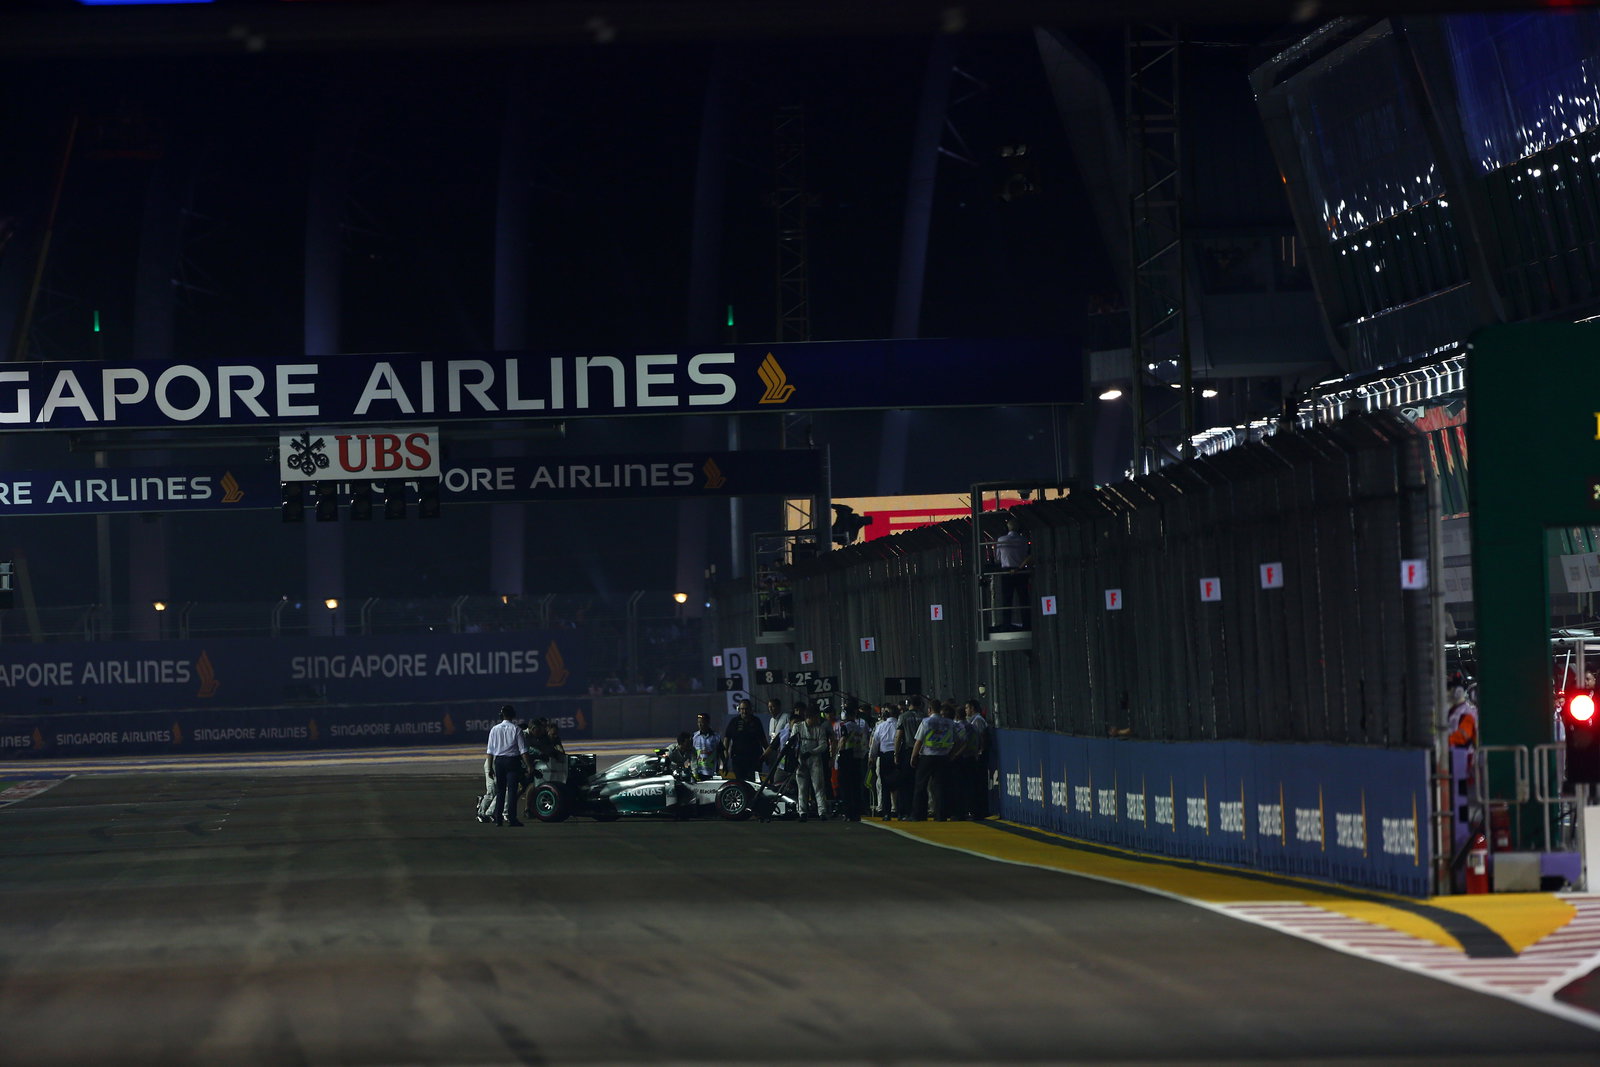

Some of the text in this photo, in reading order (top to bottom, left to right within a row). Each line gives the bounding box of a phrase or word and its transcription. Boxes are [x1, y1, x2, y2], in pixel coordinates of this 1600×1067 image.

[353, 352, 737, 415] AIRLINES
[335, 432, 432, 473] UBS
[530, 462, 695, 490] AIRLINES
[46, 476, 213, 504] AIRLINES
[1267, 567, 1274, 584] F
[1408, 565, 1416, 584] F
[1206, 582, 1213, 598] F
[1046, 600, 1052, 612] F
[1111, 592, 1118, 607] F
[933, 607, 939, 618] F
[865, 639, 871, 650] F
[81, 659, 191, 685] AIRLINES
[291, 650, 540, 679] SINGAPORE AIRLINES
[726, 679, 735, 690] 9
[765, 671, 774, 683] 8
[814, 679, 832, 693] 26
[900, 679, 906, 694] 1
[193, 725, 307, 742] SINGAPORE AIRLINES
[330, 720, 442, 737] SINGAPORE AIRLINES
[56, 730, 171, 746] SINGAPORE AIRLINES
